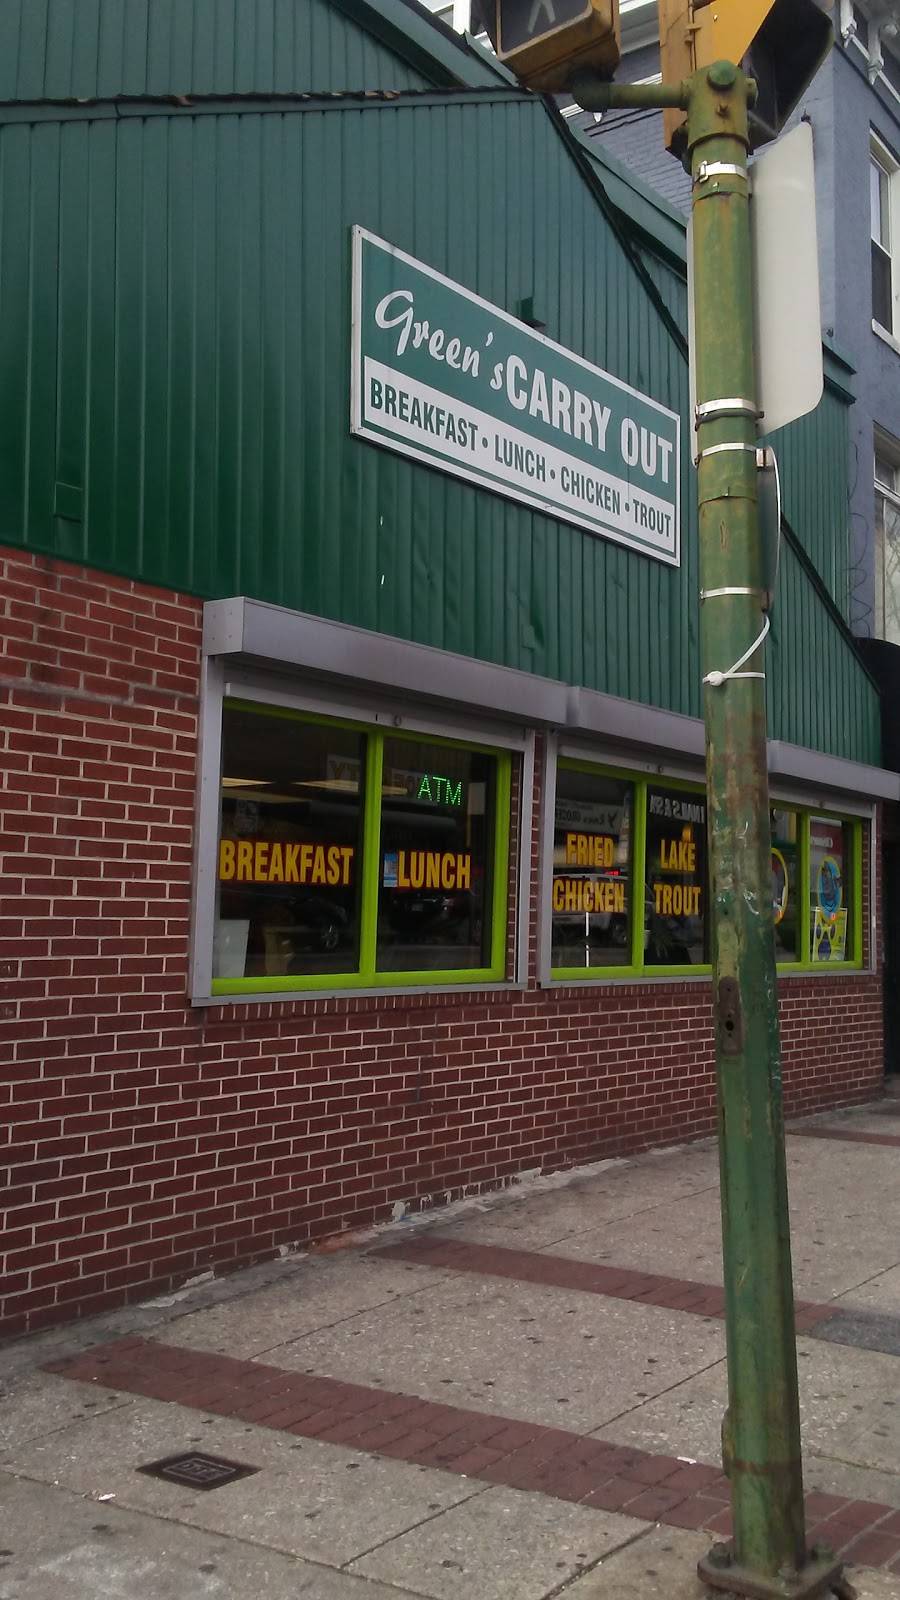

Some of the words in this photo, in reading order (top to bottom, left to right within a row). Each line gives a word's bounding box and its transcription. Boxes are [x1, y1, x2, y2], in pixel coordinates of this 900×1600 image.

[374, 290, 504, 391] Green's
[506, 355, 611, 452] CARRY
[621, 417, 673, 484] OUT
[370, 377, 478, 451] BREAKFAST
[494, 434, 546, 483] LUNCH
[560, 466, 621, 516] CHICKEN
[632, 499, 671, 538] TROUT
[417, 773, 462, 806] ATM
[219, 839, 354, 885] BREAKFAST
[398, 850, 471, 889] LUNCH
[566, 833, 614, 868] FRIED
[660, 839, 696, 872] LAKE
[553, 875, 625, 913] CHICKEN
[654, 883, 701, 917] TROUT
